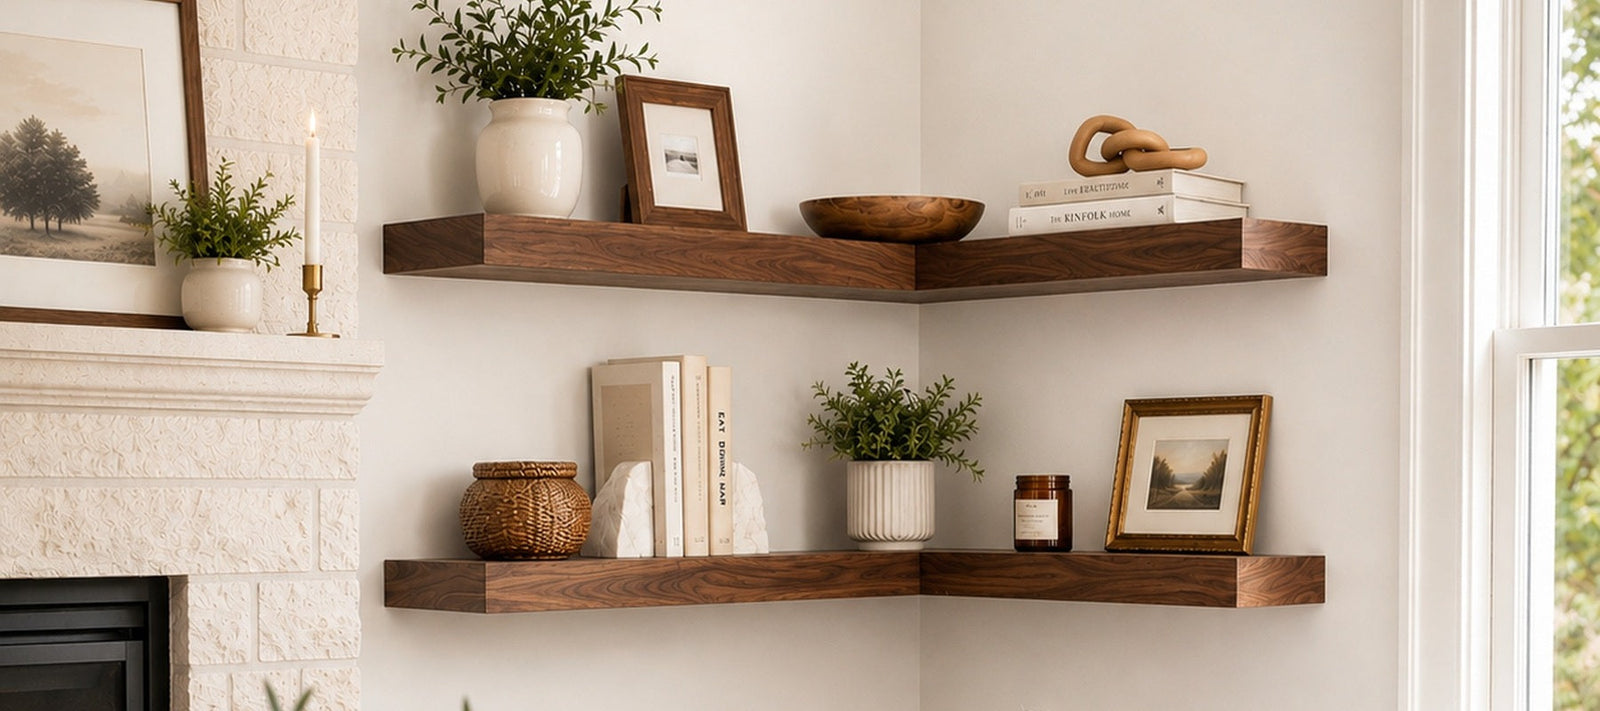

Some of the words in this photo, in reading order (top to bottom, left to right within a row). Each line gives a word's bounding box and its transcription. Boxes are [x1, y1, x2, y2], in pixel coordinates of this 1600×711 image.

[1064, 211, 1107, 223] KINFOLK
[1109, 210, 1131, 218] HOME
[718, 412, 726, 433] EAT
